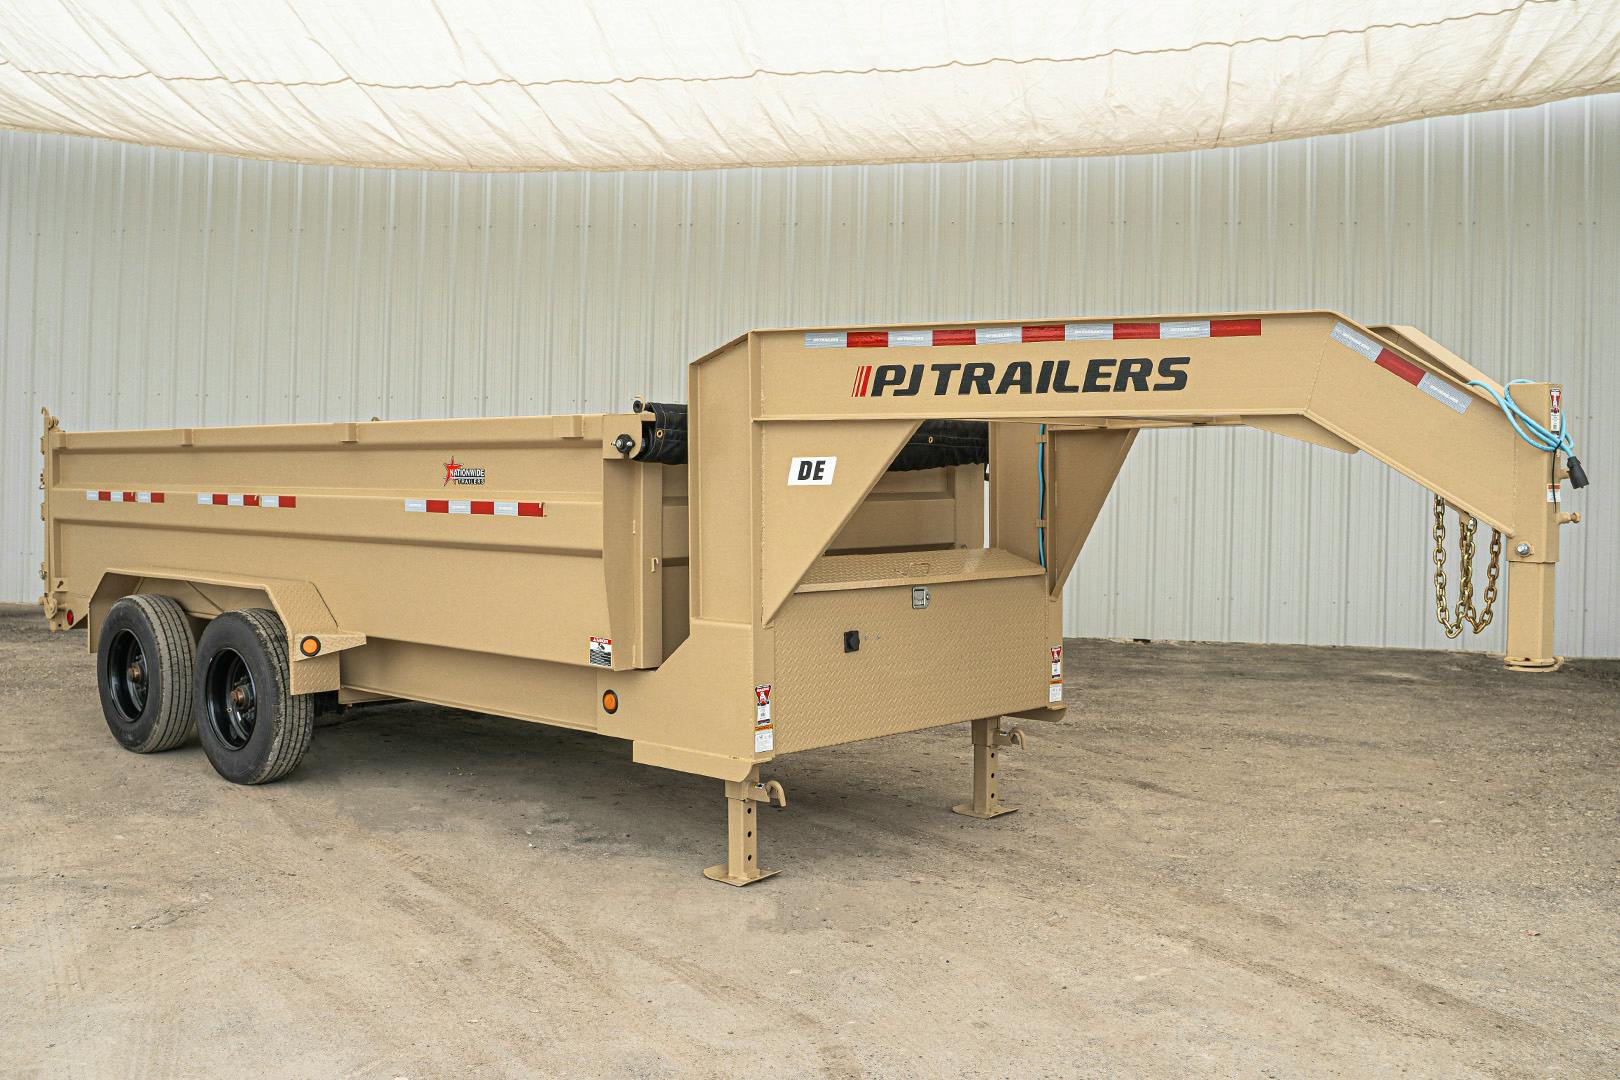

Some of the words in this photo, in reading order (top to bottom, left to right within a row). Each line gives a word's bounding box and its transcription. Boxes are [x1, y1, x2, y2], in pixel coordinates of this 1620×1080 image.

[870, 364, 924, 397] PJ
[930, 356, 1191, 396] TRAILERS
[450, 468, 485, 477] NATIONWIDE
[797, 460, 826, 481] DE
